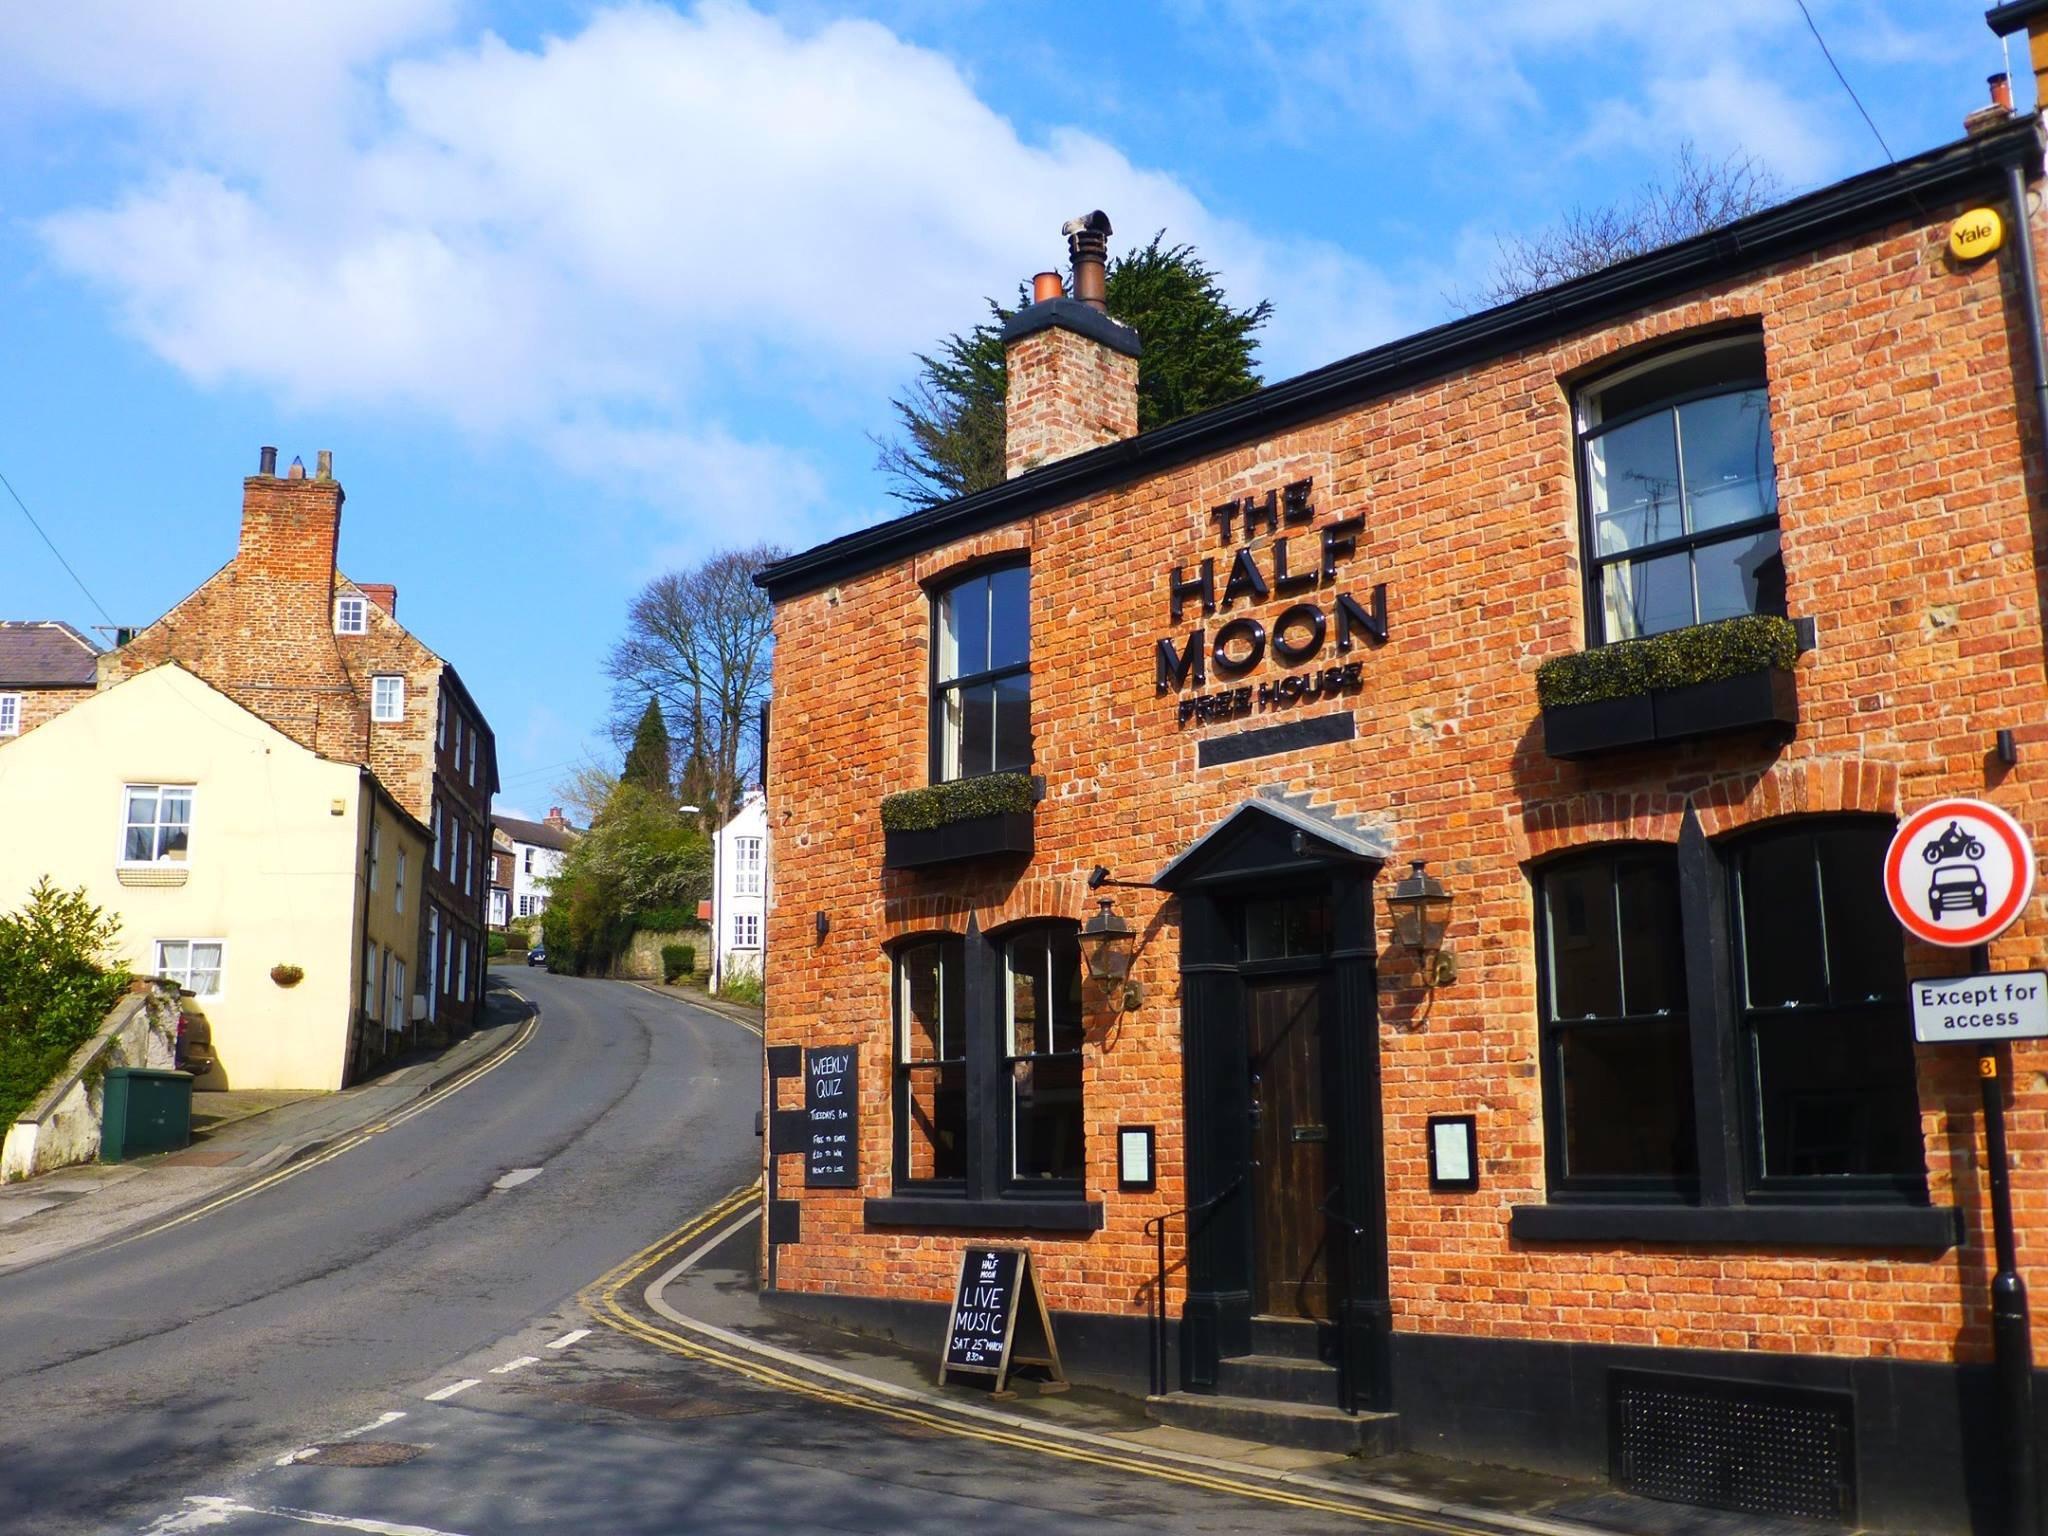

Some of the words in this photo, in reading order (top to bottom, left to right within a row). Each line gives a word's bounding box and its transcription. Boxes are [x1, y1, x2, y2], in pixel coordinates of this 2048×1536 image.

[1955, 225, 1992, 245] Yale
[1212, 476, 1315, 541] THE
[1170, 512, 1366, 622] HALF
[1157, 583, 1388, 696] MOON
[1178, 685, 1253, 726] FREE
[1259, 661, 1364, 709] HOUSE
[1921, 985, 1998, 1007] Except
[2005, 984, 2037, 1002] for
[1944, 1009, 2019, 1029] access
[811, 1055, 849, 1076] WEEKLY
[816, 1078, 844, 1098] QUIZ
[980, 1270, 997, 1279] MOON
[981, 1260, 999, 1270] HALF
[963, 1287, 1004, 1309] LIVE
[955, 1311, 1002, 1335] MUSIC
